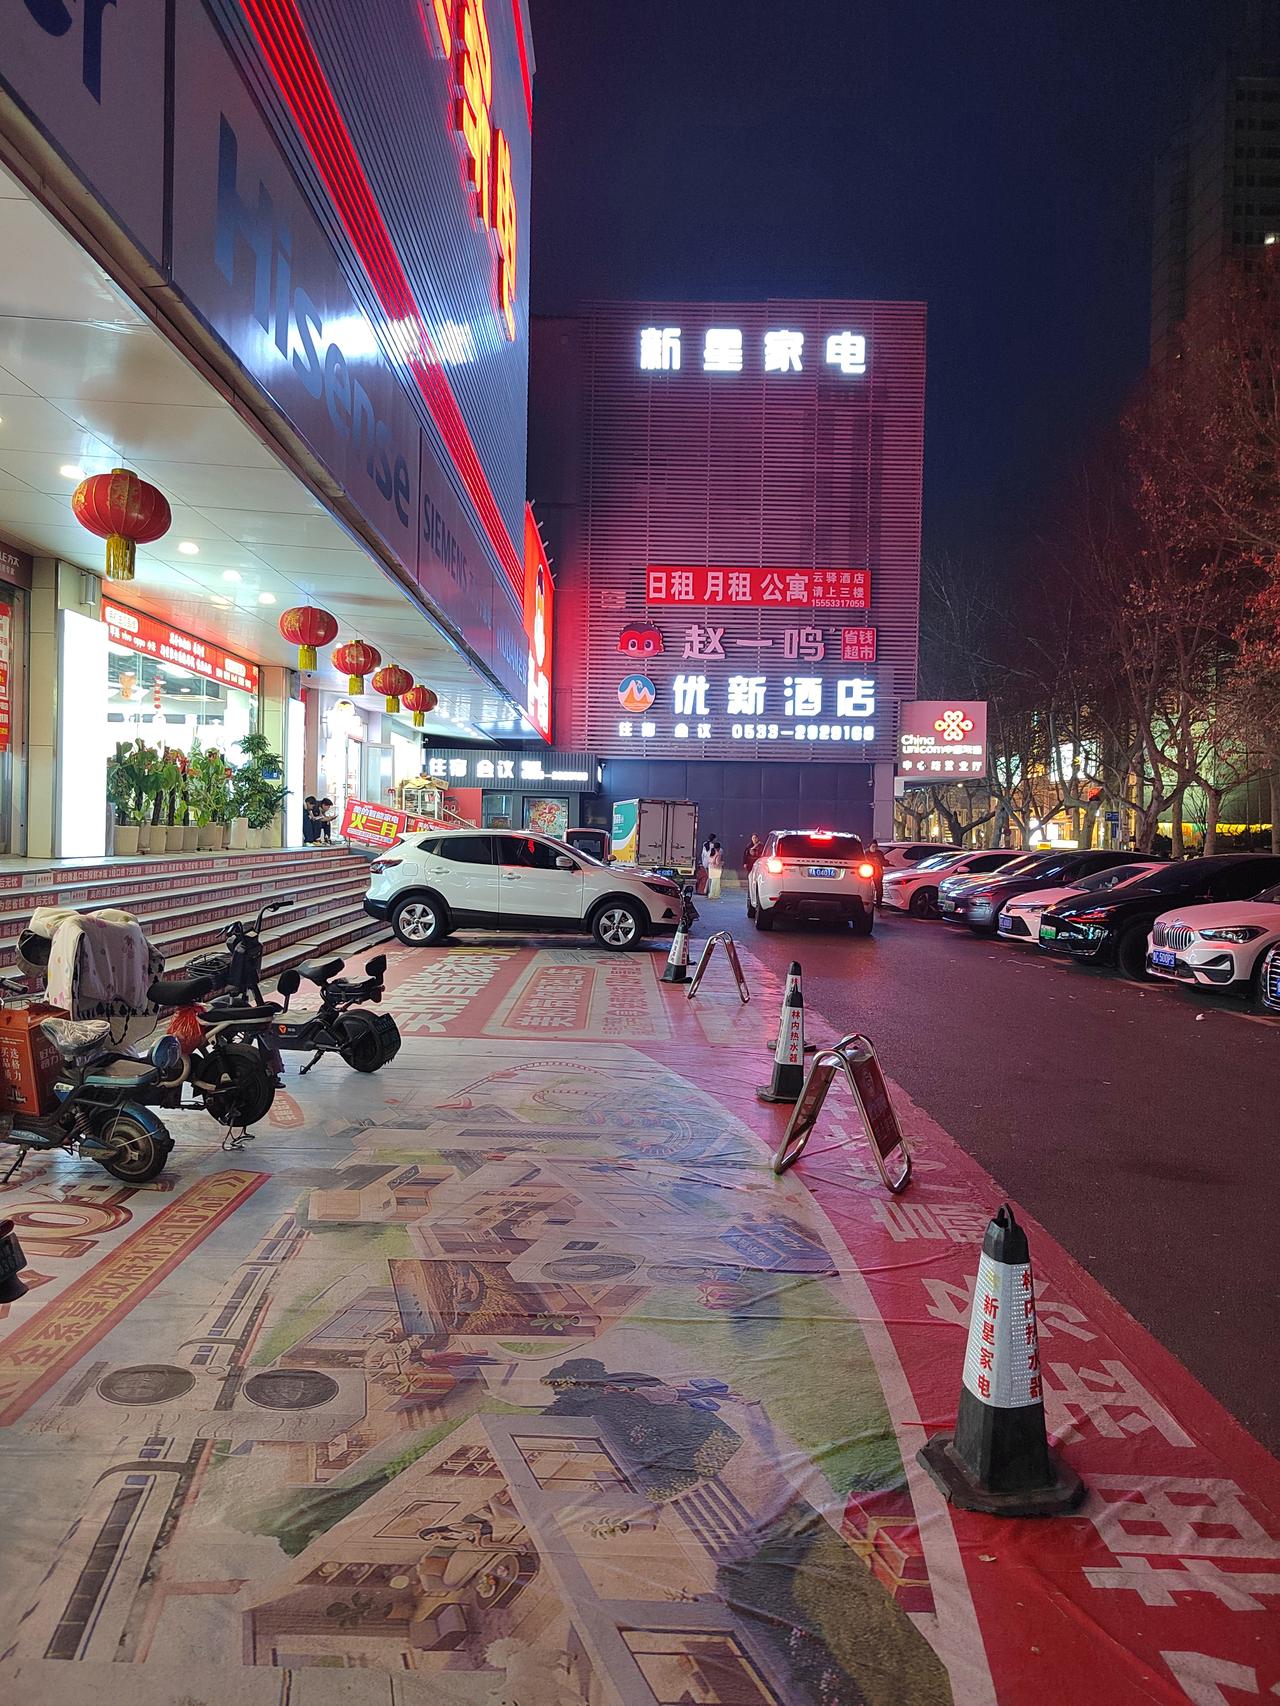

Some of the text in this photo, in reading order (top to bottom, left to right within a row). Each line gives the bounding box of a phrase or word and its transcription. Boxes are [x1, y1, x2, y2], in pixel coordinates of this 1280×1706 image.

[214, 111, 411, 528] Hisense
[639, 327, 867, 374] 新星家电
[423, 493, 468, 593] SIEMENS
[649, 570, 809, 603] 日租 月租 公寓
[812, 572, 865, 585] 云驿酒店
[811, 599, 865, 608] 15553317059
[812, 586, 865, 598] 请上三楼
[682, 624, 825, 662] 赵一鸣
[844, 630, 873, 644] 省钱
[844, 645, 873, 660] 超市
[674, 722, 711, 739] 会议
[901, 733, 935, 745] China
[348, 812, 398, 838] 火三月
[788, 1010, 801, 1063] 林内热水器
[977, 1294, 999, 1398] 新星家电
